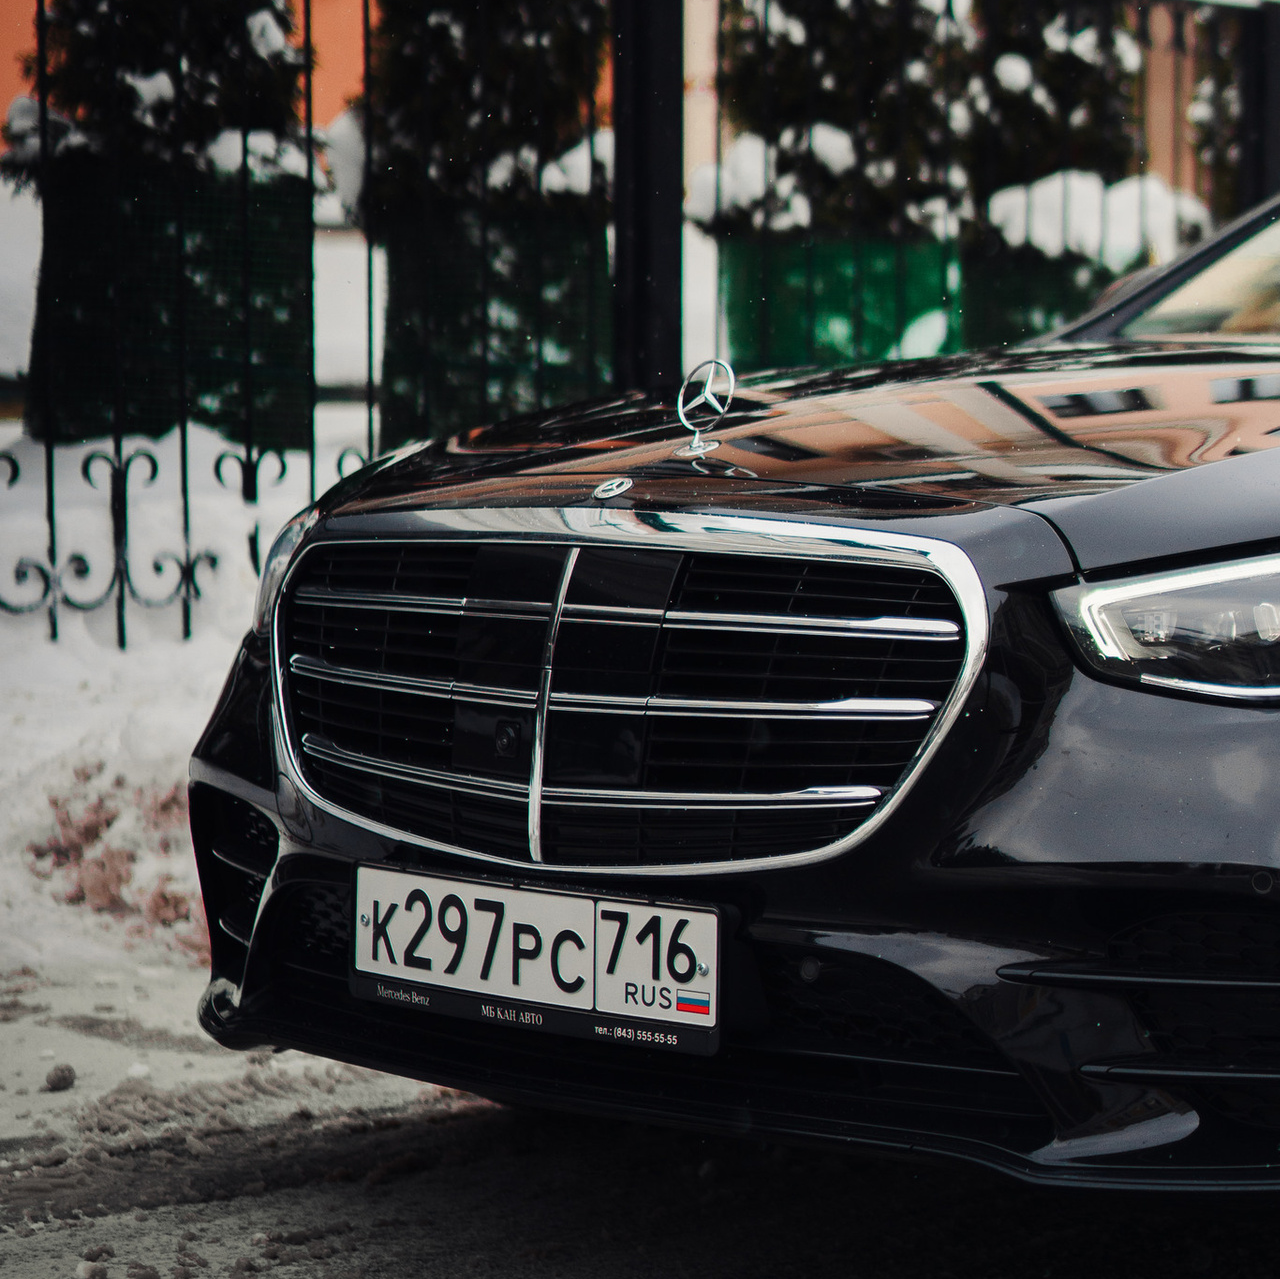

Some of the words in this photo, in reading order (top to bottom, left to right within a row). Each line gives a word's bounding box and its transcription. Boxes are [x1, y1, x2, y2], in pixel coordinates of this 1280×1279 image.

[600, 909, 698, 984] 716
[625, 982, 673, 1010] RUS
[519, 1012, 543, 1025] АВТО
[613, 1026, 635, 1042] (843)
[636, 1030, 678, 1045] 555-55-55
